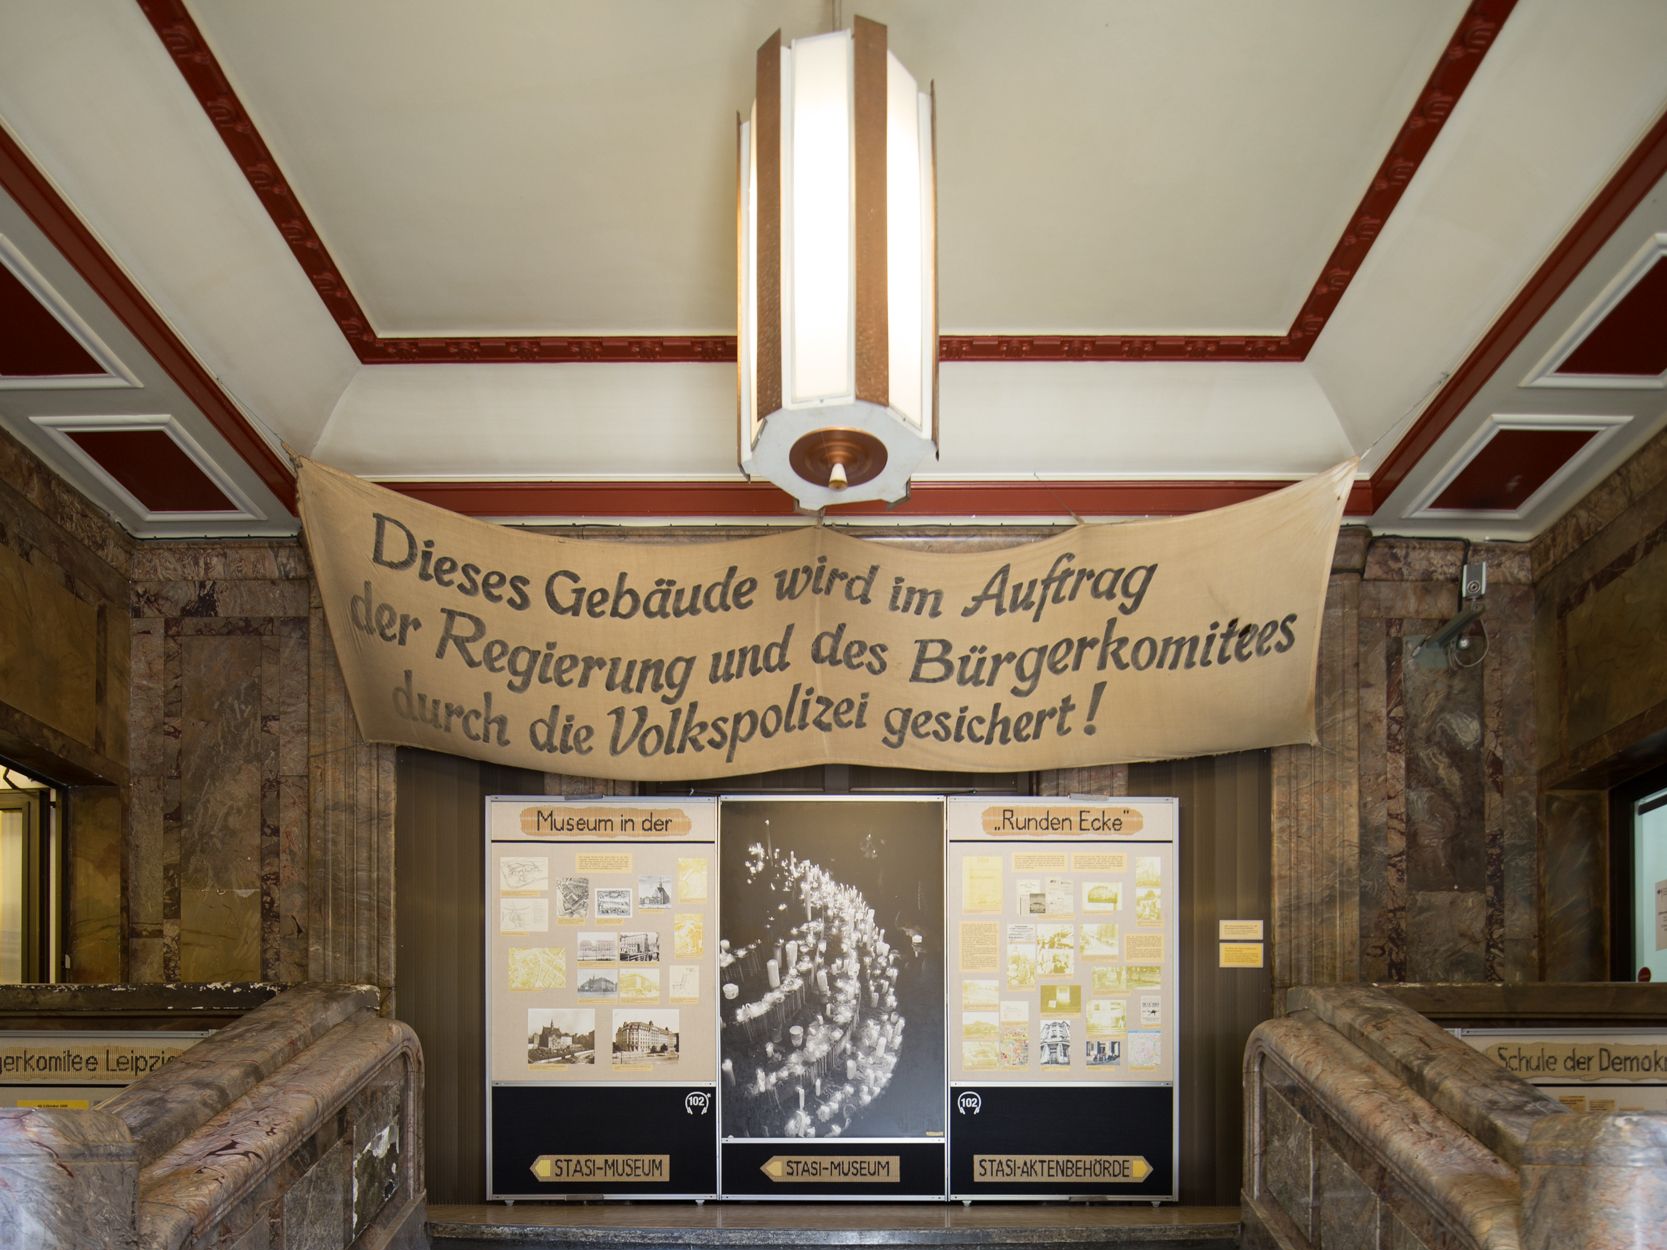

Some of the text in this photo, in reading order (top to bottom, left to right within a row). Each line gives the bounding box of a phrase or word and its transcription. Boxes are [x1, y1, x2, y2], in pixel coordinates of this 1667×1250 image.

[372, 512, 1158, 622] Dieses Gebäude wird im Auftrag
[351, 580, 1298, 705] der Regierung und des Bürgerkomitees
[391, 669, 511, 747] durch
[528, 704, 594, 756] die
[606, 682, 869, 763] Volkspolizei
[536, 809, 673, 832] Museum in der
[1497, 1047, 1558, 1072] Schule
[1563, 1048, 1595, 1072] der
[688, 1096, 705, 1107] 102
[960, 1097, 978, 1108] 102
[554, 1158, 663, 1177] STASI-MUSEUM
[786, 1160, 890, 1177] STASI-MUSEUM
[978, 1157, 1130, 1178] STASI-AKTENBEHÖRDE
